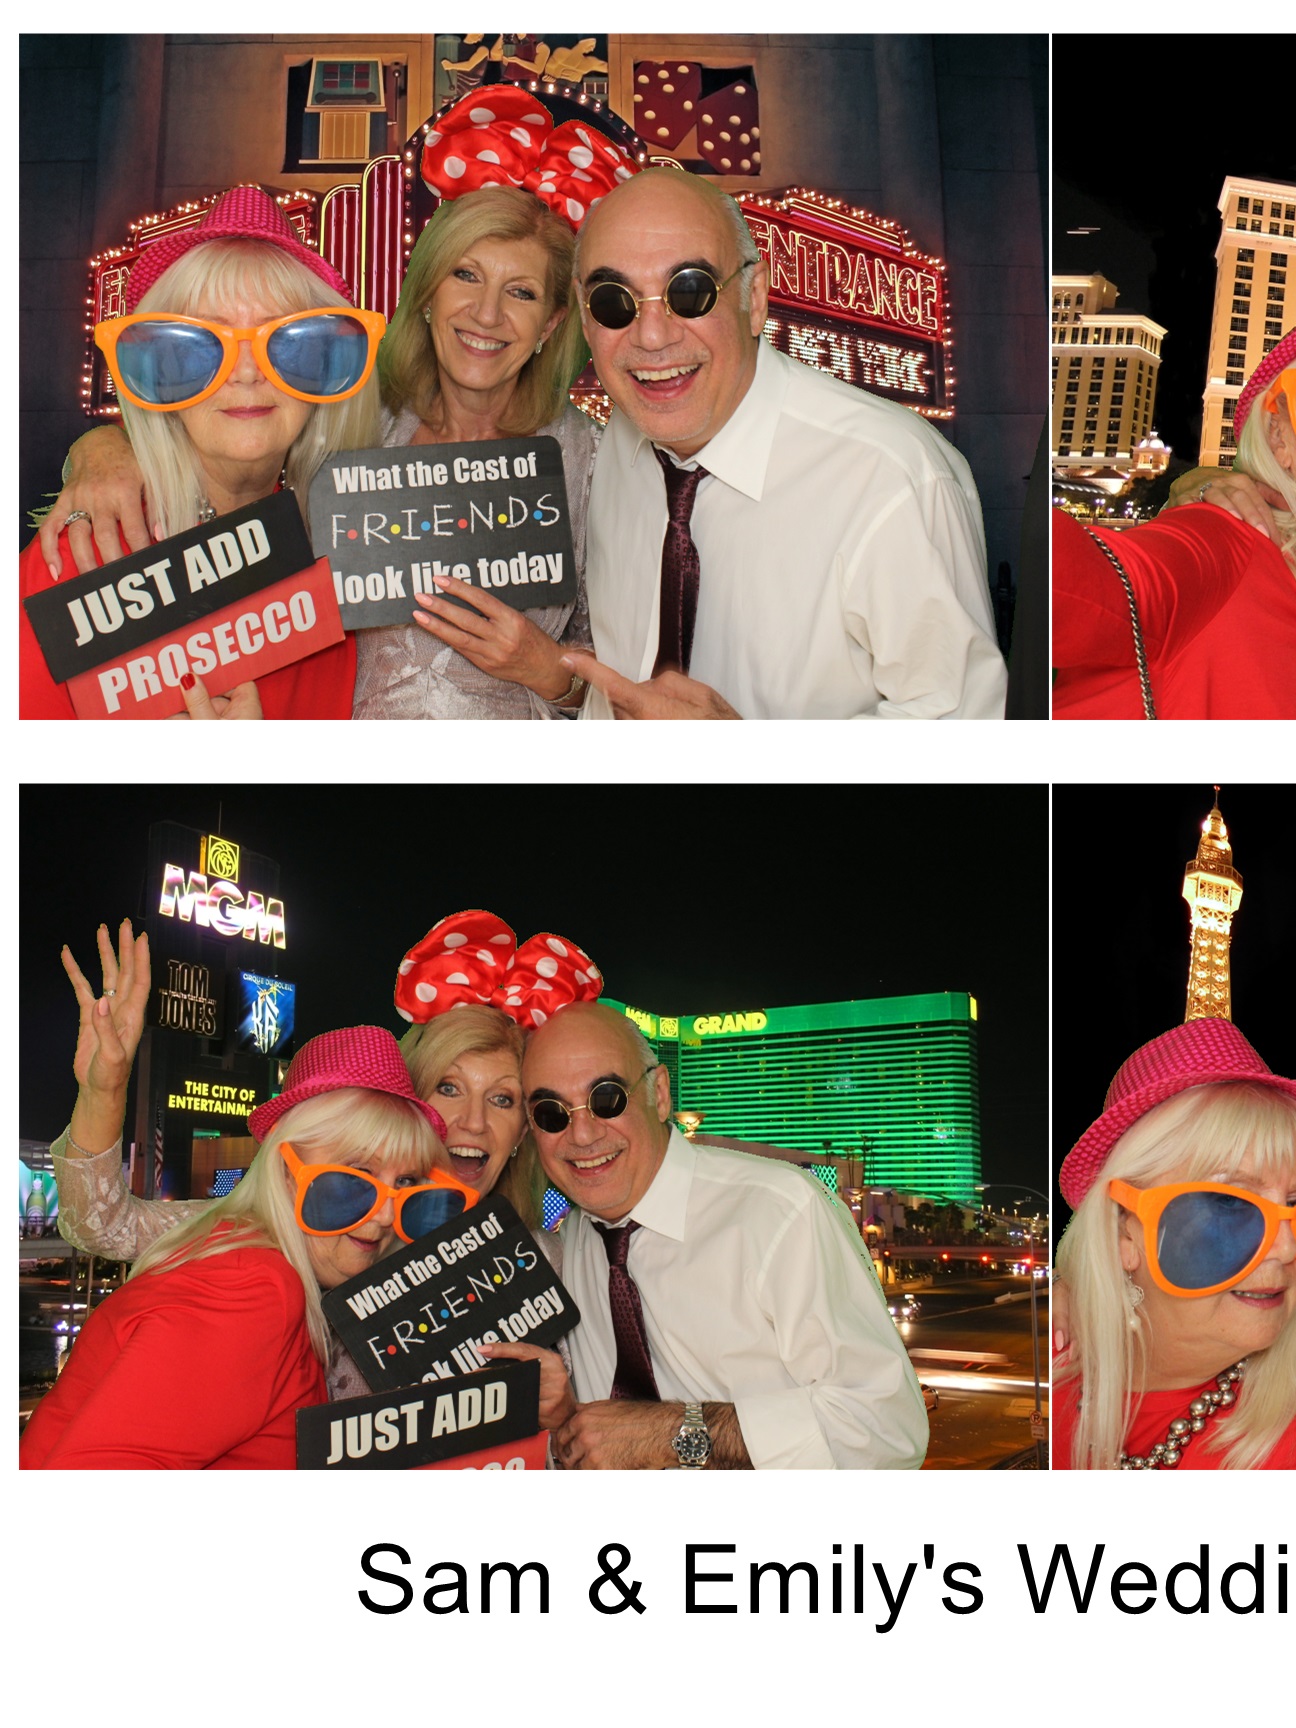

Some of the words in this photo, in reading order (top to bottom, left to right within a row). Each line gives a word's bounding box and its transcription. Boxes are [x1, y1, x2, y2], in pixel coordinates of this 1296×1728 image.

[332, 464, 403, 494] What
[406, 460, 449, 487] the
[453, 456, 510, 484] Cast
[514, 451, 537, 479] of
[67, 558, 176, 647] JUST
[183, 519, 271, 594] ADD
[333, 565, 406, 604] look
[411, 560, 472, 595] like
[477, 551, 564, 589] today
[97, 590, 317, 715] PROSECCO
[158, 863, 286, 950] MGM
[168, 959, 209, 998] TOM
[243, 973, 264, 986] CIRQUE
[274, 981, 294, 992] SOLEIL
[159, 994, 217, 1036] JONES
[693, 1012, 768, 1036] GRAND
[168, 1094, 257, 1117] ENTERTAINME
[185, 1081, 209, 1096] THE
[211, 1085, 237, 1100] CITY
[239, 1088, 256, 1102] OF
[346, 1270, 410, 1321] What
[403, 1253, 442, 1279] the
[437, 1228, 487, 1267] Cast
[480, 1212, 504, 1241] of
[498, 1285, 566, 1344] today
[326, 1400, 424, 1465] JUST
[431, 1380, 508, 1438] ADD
